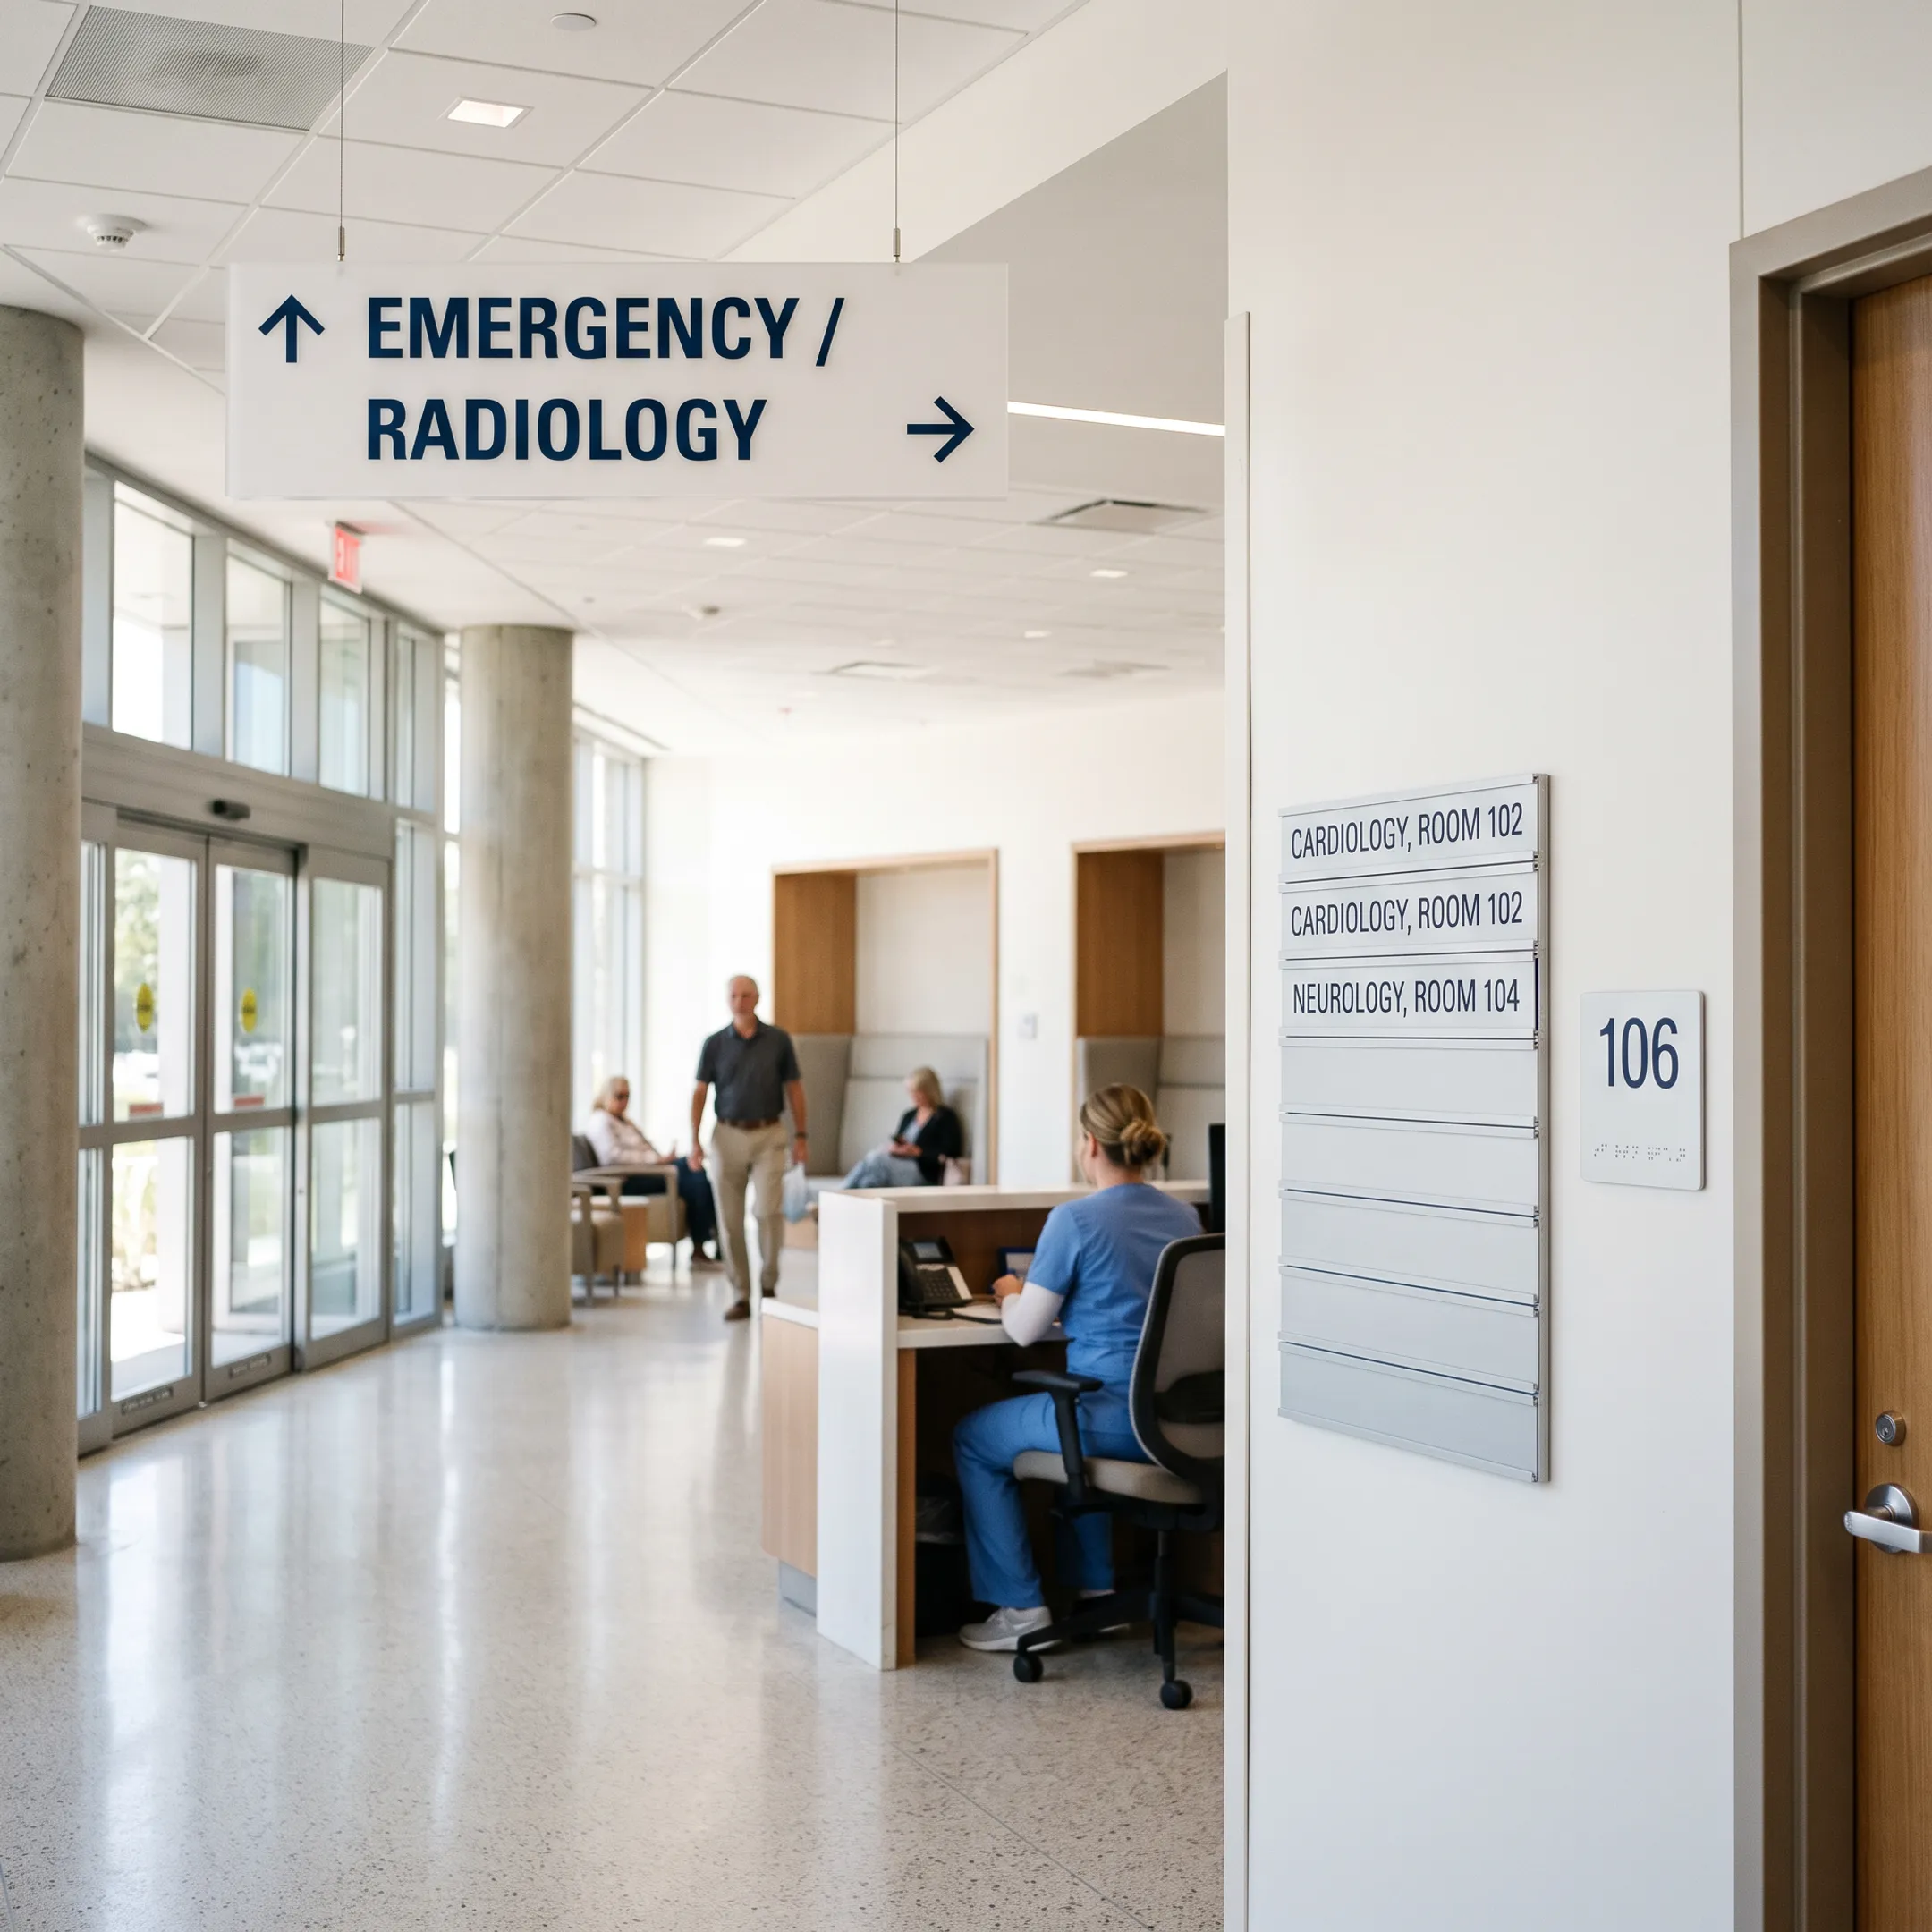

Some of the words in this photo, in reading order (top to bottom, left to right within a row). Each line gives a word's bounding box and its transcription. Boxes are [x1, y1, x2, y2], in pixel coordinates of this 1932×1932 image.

[368, 296, 801, 360] EMERGENCY
[815, 297, 845, 368] /
[368, 398, 768, 462] RADIOLOGY
[1291, 815, 1411, 860] CARDIOLOGY,
[1419, 806, 1480, 846] ROOM
[1487, 801, 1523, 838] 102
[1291, 898, 1411, 936] CARDIOLOGY,
[1419, 893, 1480, 929] ROOM
[1487, 890, 1523, 925] 102
[1293, 980, 1407, 1018] NEUROLOGY,
[1415, 979, 1476, 1013] ROOM
[1484, 979, 1521, 1013] 104
[1599, 1017, 1679, 1089] 106
